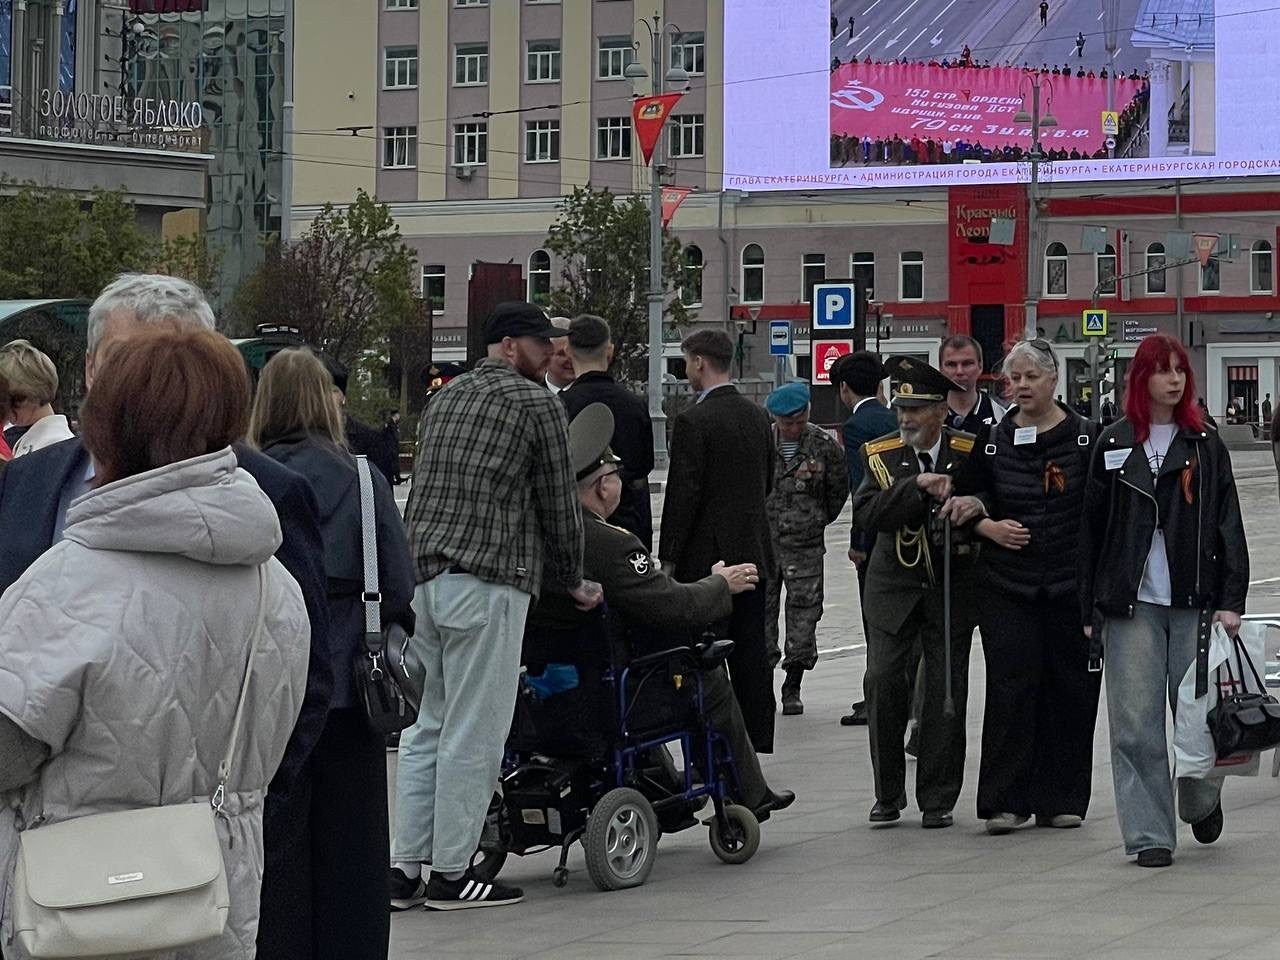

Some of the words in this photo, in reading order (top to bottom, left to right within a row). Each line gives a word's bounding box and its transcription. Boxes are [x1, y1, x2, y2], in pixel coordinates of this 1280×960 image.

[905, 88, 930, 98] 150
[971, 95, 1022, 105] ОРДЕНА
[40, 88, 123, 123] ЗОЛОТОЕ
[132, 97, 202, 129] ЯБЛОКО
[910, 117, 947, 130] 79
[729, 176, 762, 186] ГЛАВА
[764, 173, 850, 185] ЕКАТЕРИНБУРГА
[860, 169, 953, 182] АДМИНИСТРАЦИЯ
[956, 168, 999, 179] ГОРОДА
[1102, 161, 1215, 173] ЕКАТЕРИНБУРГСКАЯ
[956, 223, 990, 238] Леоп
[825, 294, 845, 321] P
